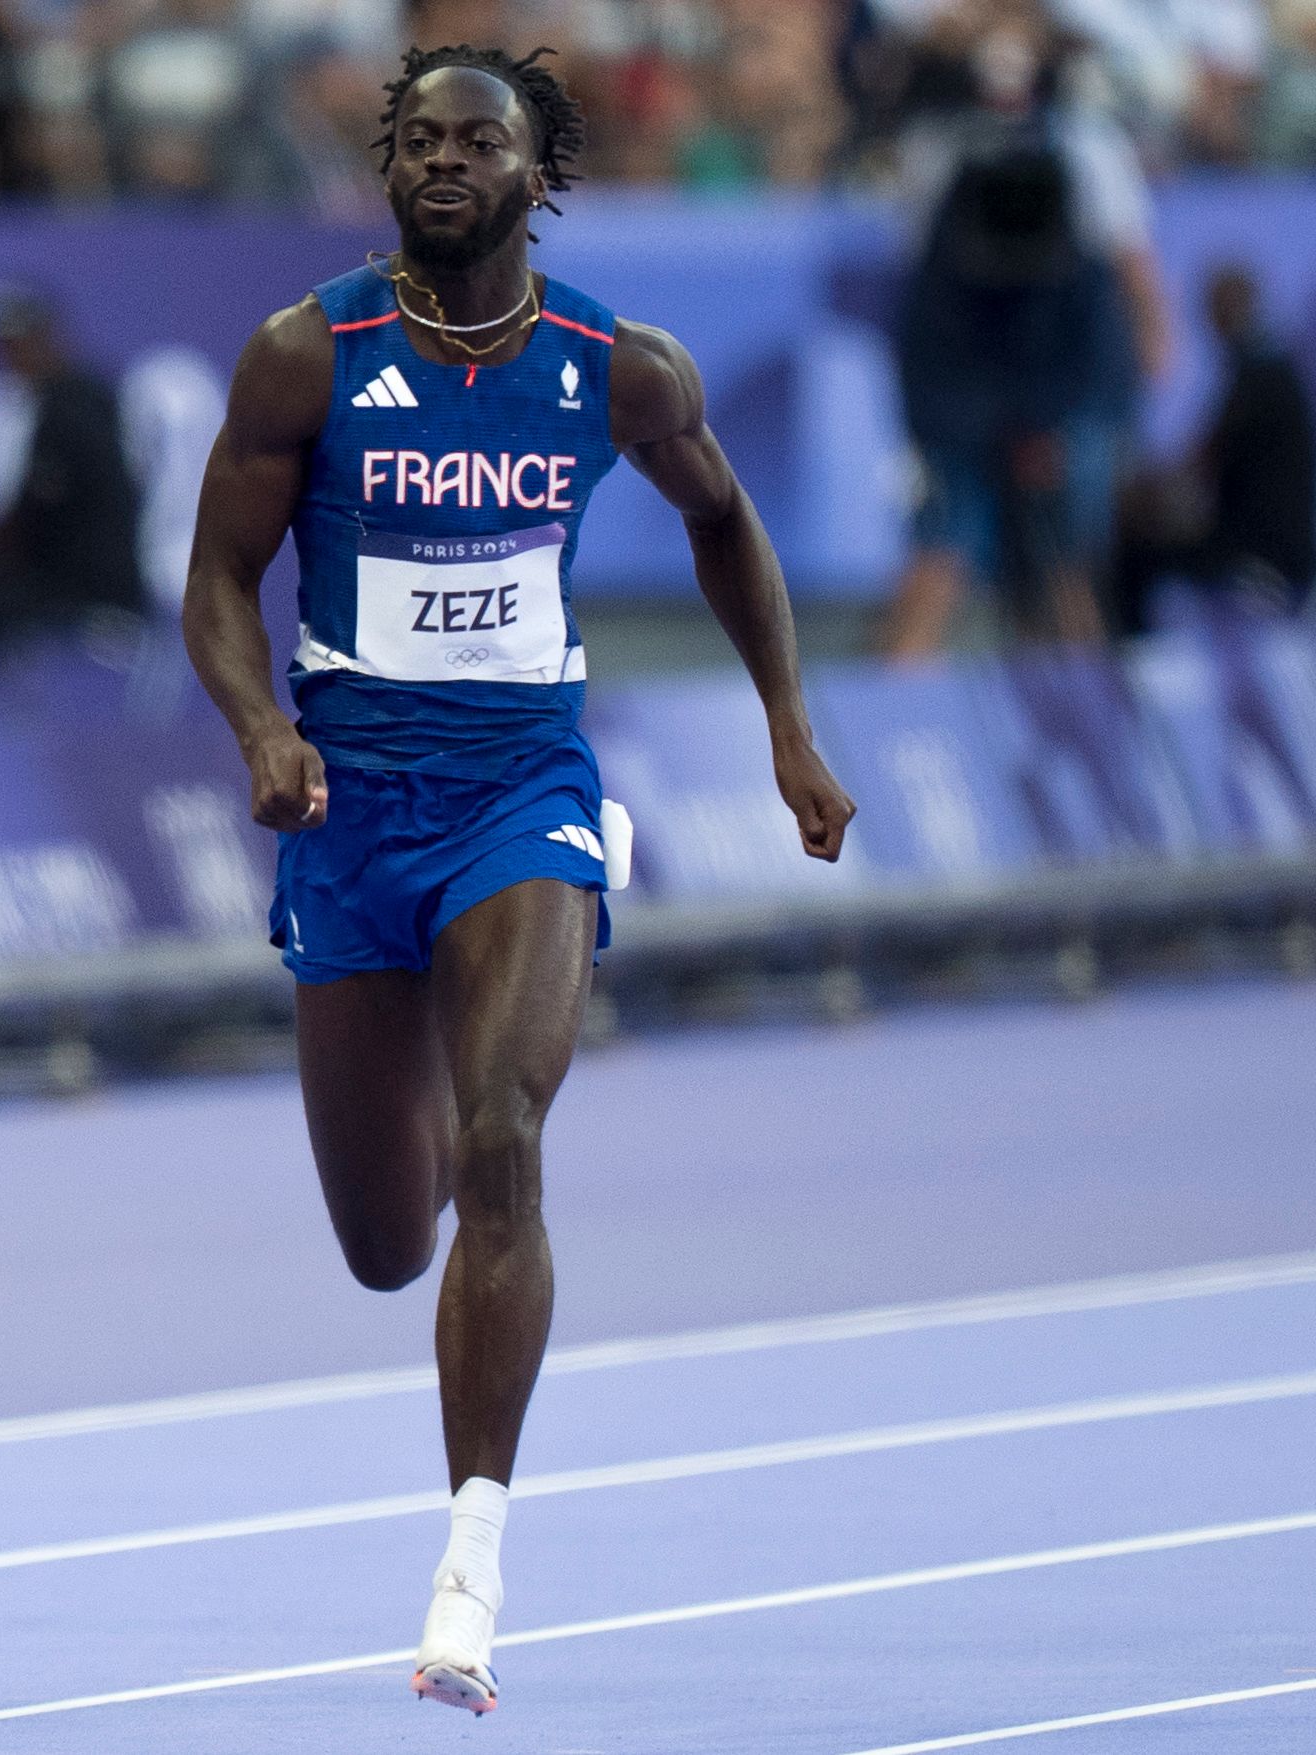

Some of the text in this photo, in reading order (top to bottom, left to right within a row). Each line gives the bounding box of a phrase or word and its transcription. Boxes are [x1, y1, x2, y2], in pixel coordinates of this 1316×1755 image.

[363, 450, 577, 510] FRANCE
[412, 539, 517, 557] PARIS 2024
[410, 582, 520, 633] ZEZE
